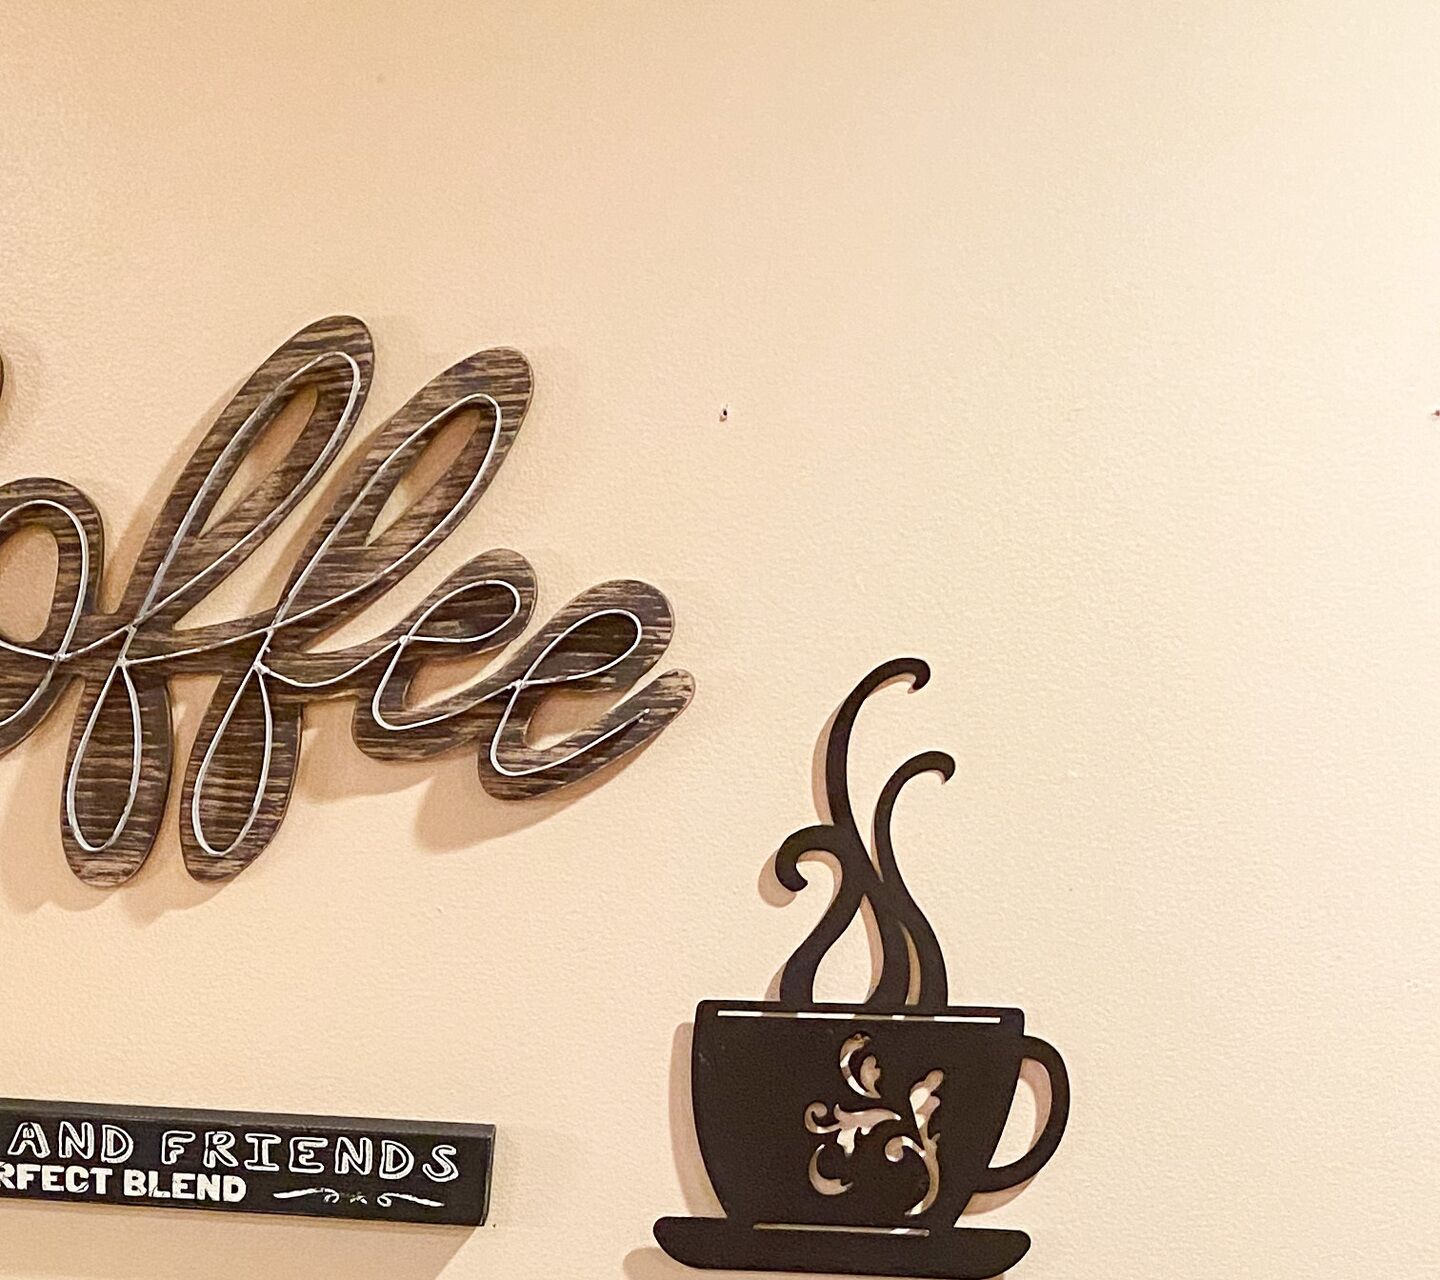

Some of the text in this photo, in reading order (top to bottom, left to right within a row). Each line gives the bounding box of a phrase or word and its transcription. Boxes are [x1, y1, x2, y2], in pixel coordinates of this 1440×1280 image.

[9, 1119, 133, 1164] AND
[160, 1129, 460, 1183] FRIENDS
[122, 1168, 247, 1204] BLEND
